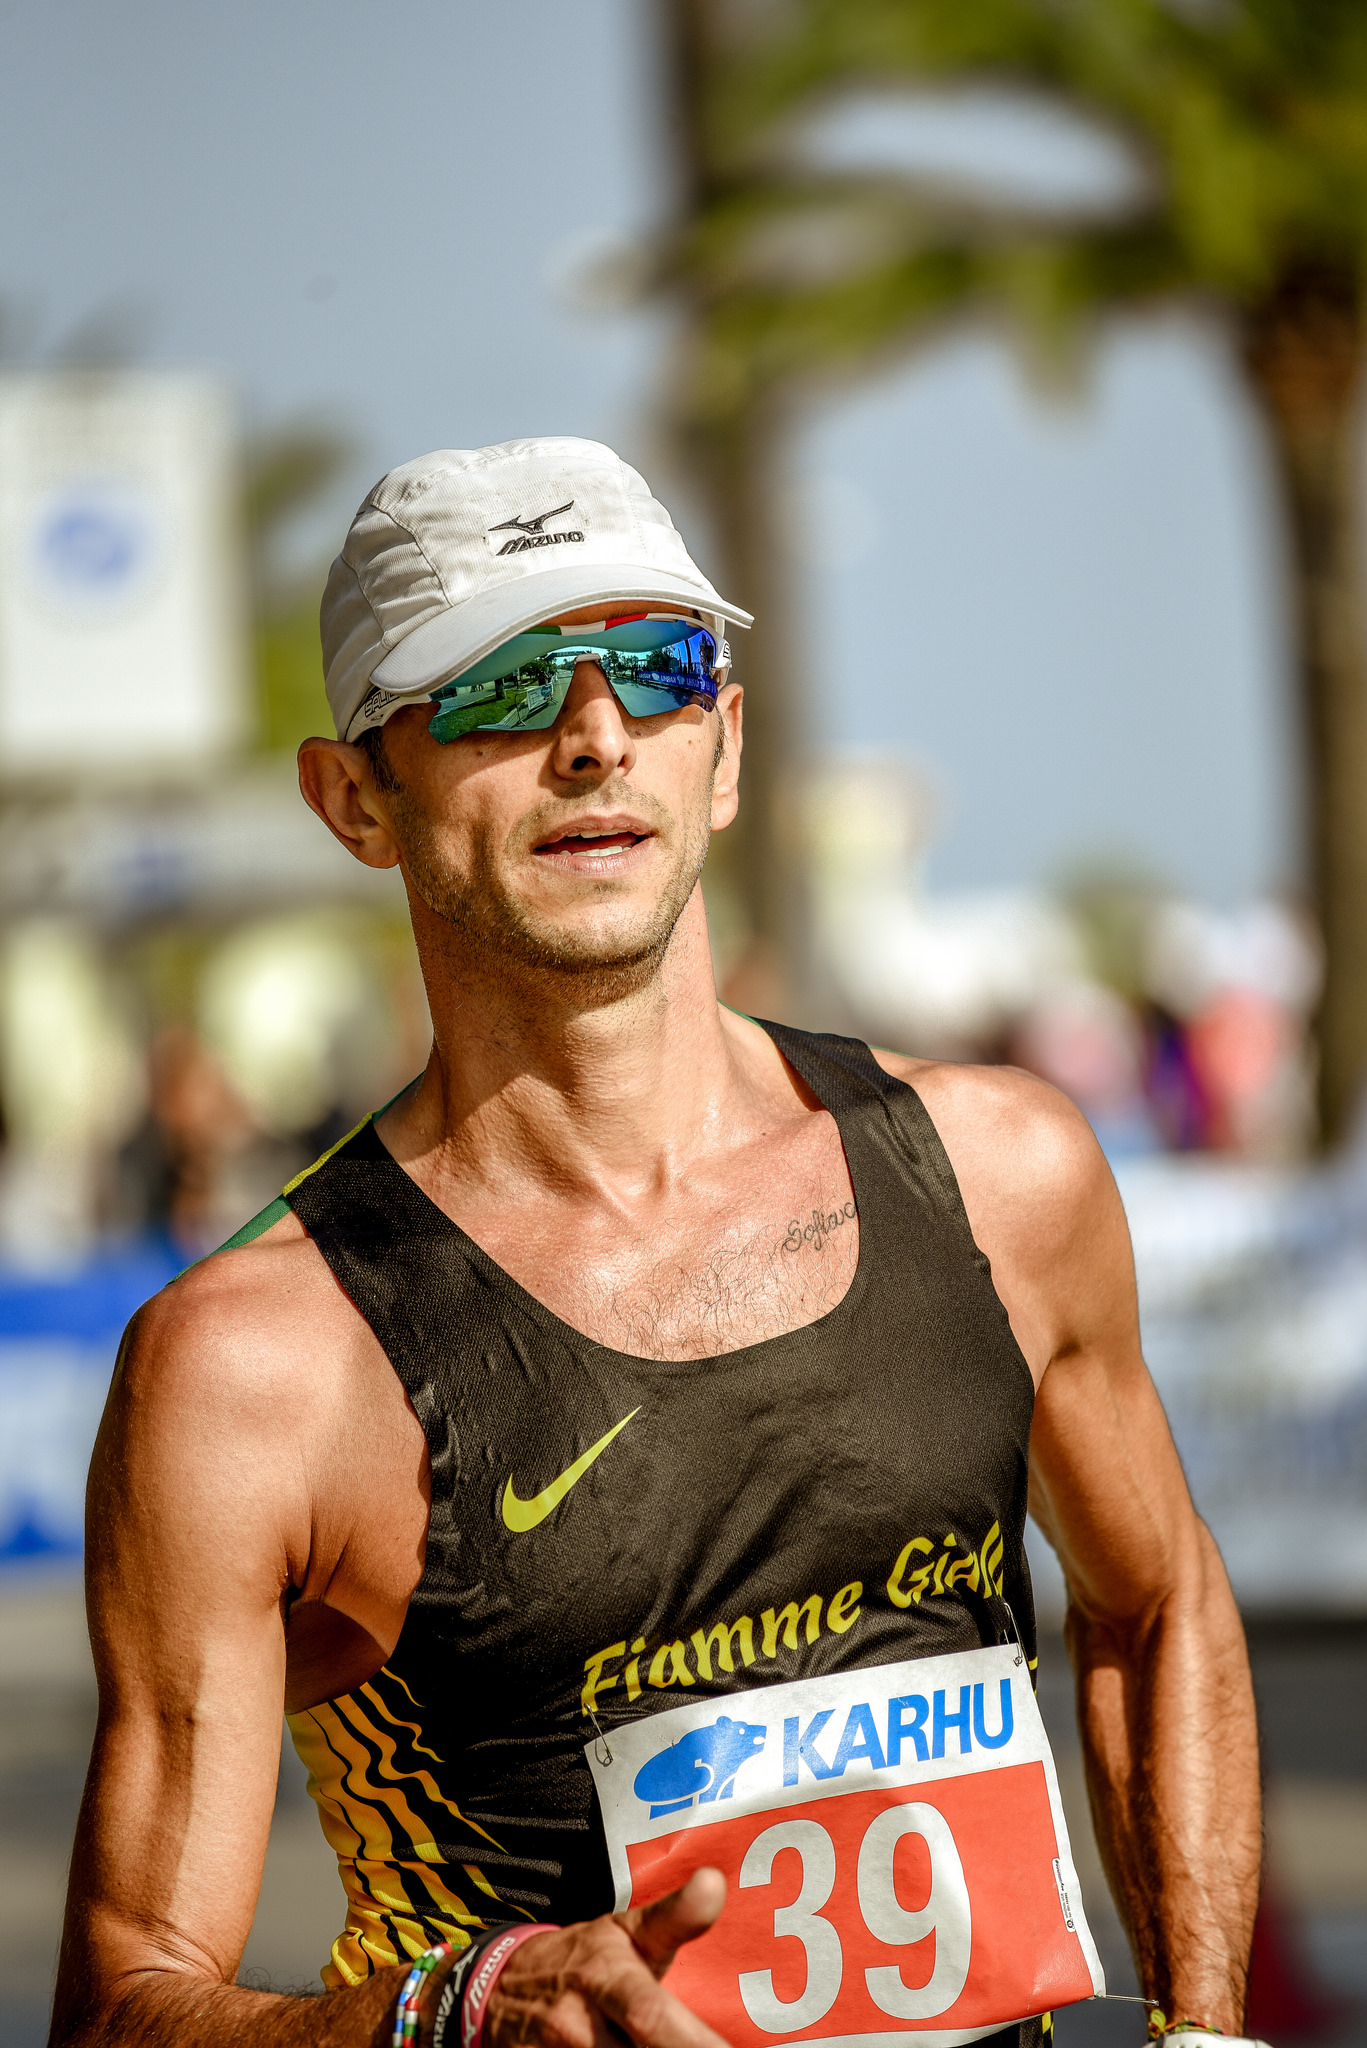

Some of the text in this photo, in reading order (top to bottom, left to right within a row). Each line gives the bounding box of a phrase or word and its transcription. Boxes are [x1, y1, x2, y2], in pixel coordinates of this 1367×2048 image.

[581, 1580, 864, 1717] Fiamme
[783, 1678, 1014, 1788] KARHU
[738, 1801, 973, 2035] 39
